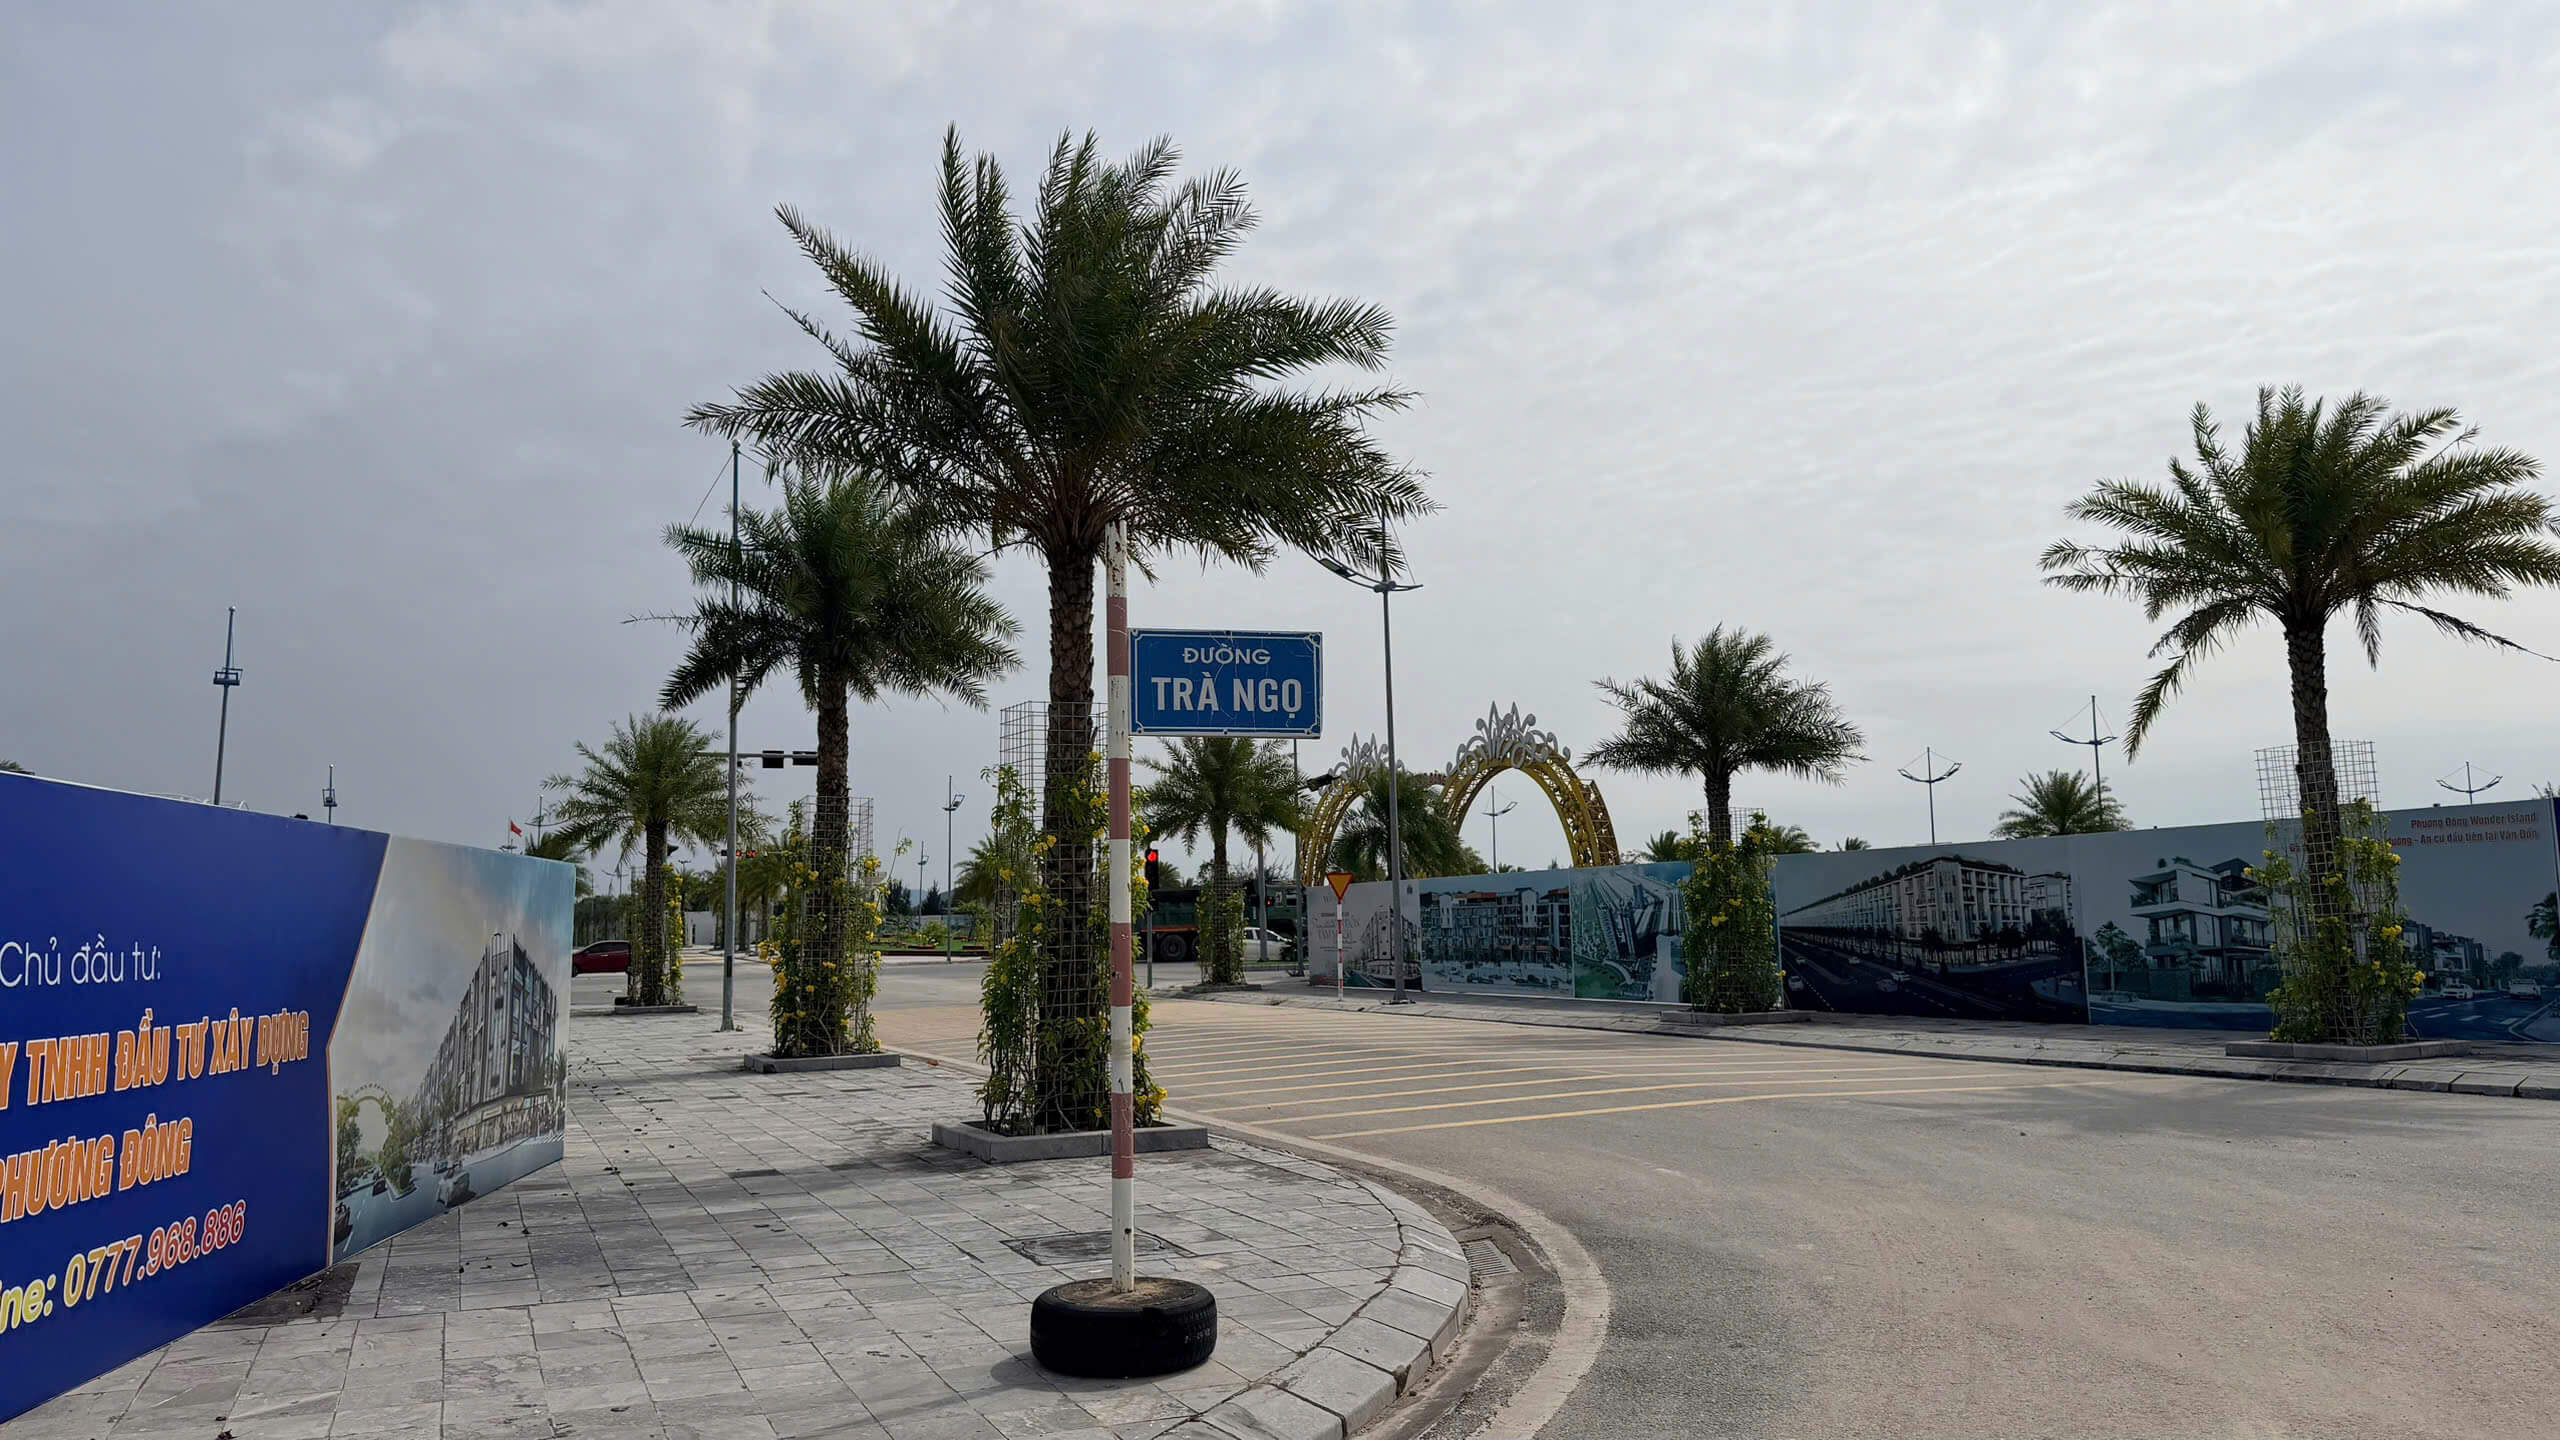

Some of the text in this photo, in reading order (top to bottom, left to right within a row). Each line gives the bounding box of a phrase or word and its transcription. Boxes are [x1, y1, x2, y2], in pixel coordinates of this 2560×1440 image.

[1182, 643, 1272, 665] ĐƯỜNG
[1151, 671, 1303, 719] TRÀ NGỌ
[2470, 814, 2505, 826] Wonder
[2507, 812, 2537, 825] Island
[0, 933, 161, 988] Chủ đầu tư:
[26, 1032, 110, 1106] TNHH
[114, 1008, 172, 1092] ĐẦU
[176, 1016, 210, 1081] TƯ
[208, 1007, 254, 1076] XÂY
[256, 1007, 310, 1076] DỰNG
[118, 1112, 194, 1193] ĐÔNG
[62, 1198, 248, 1309] 0777.968.886
